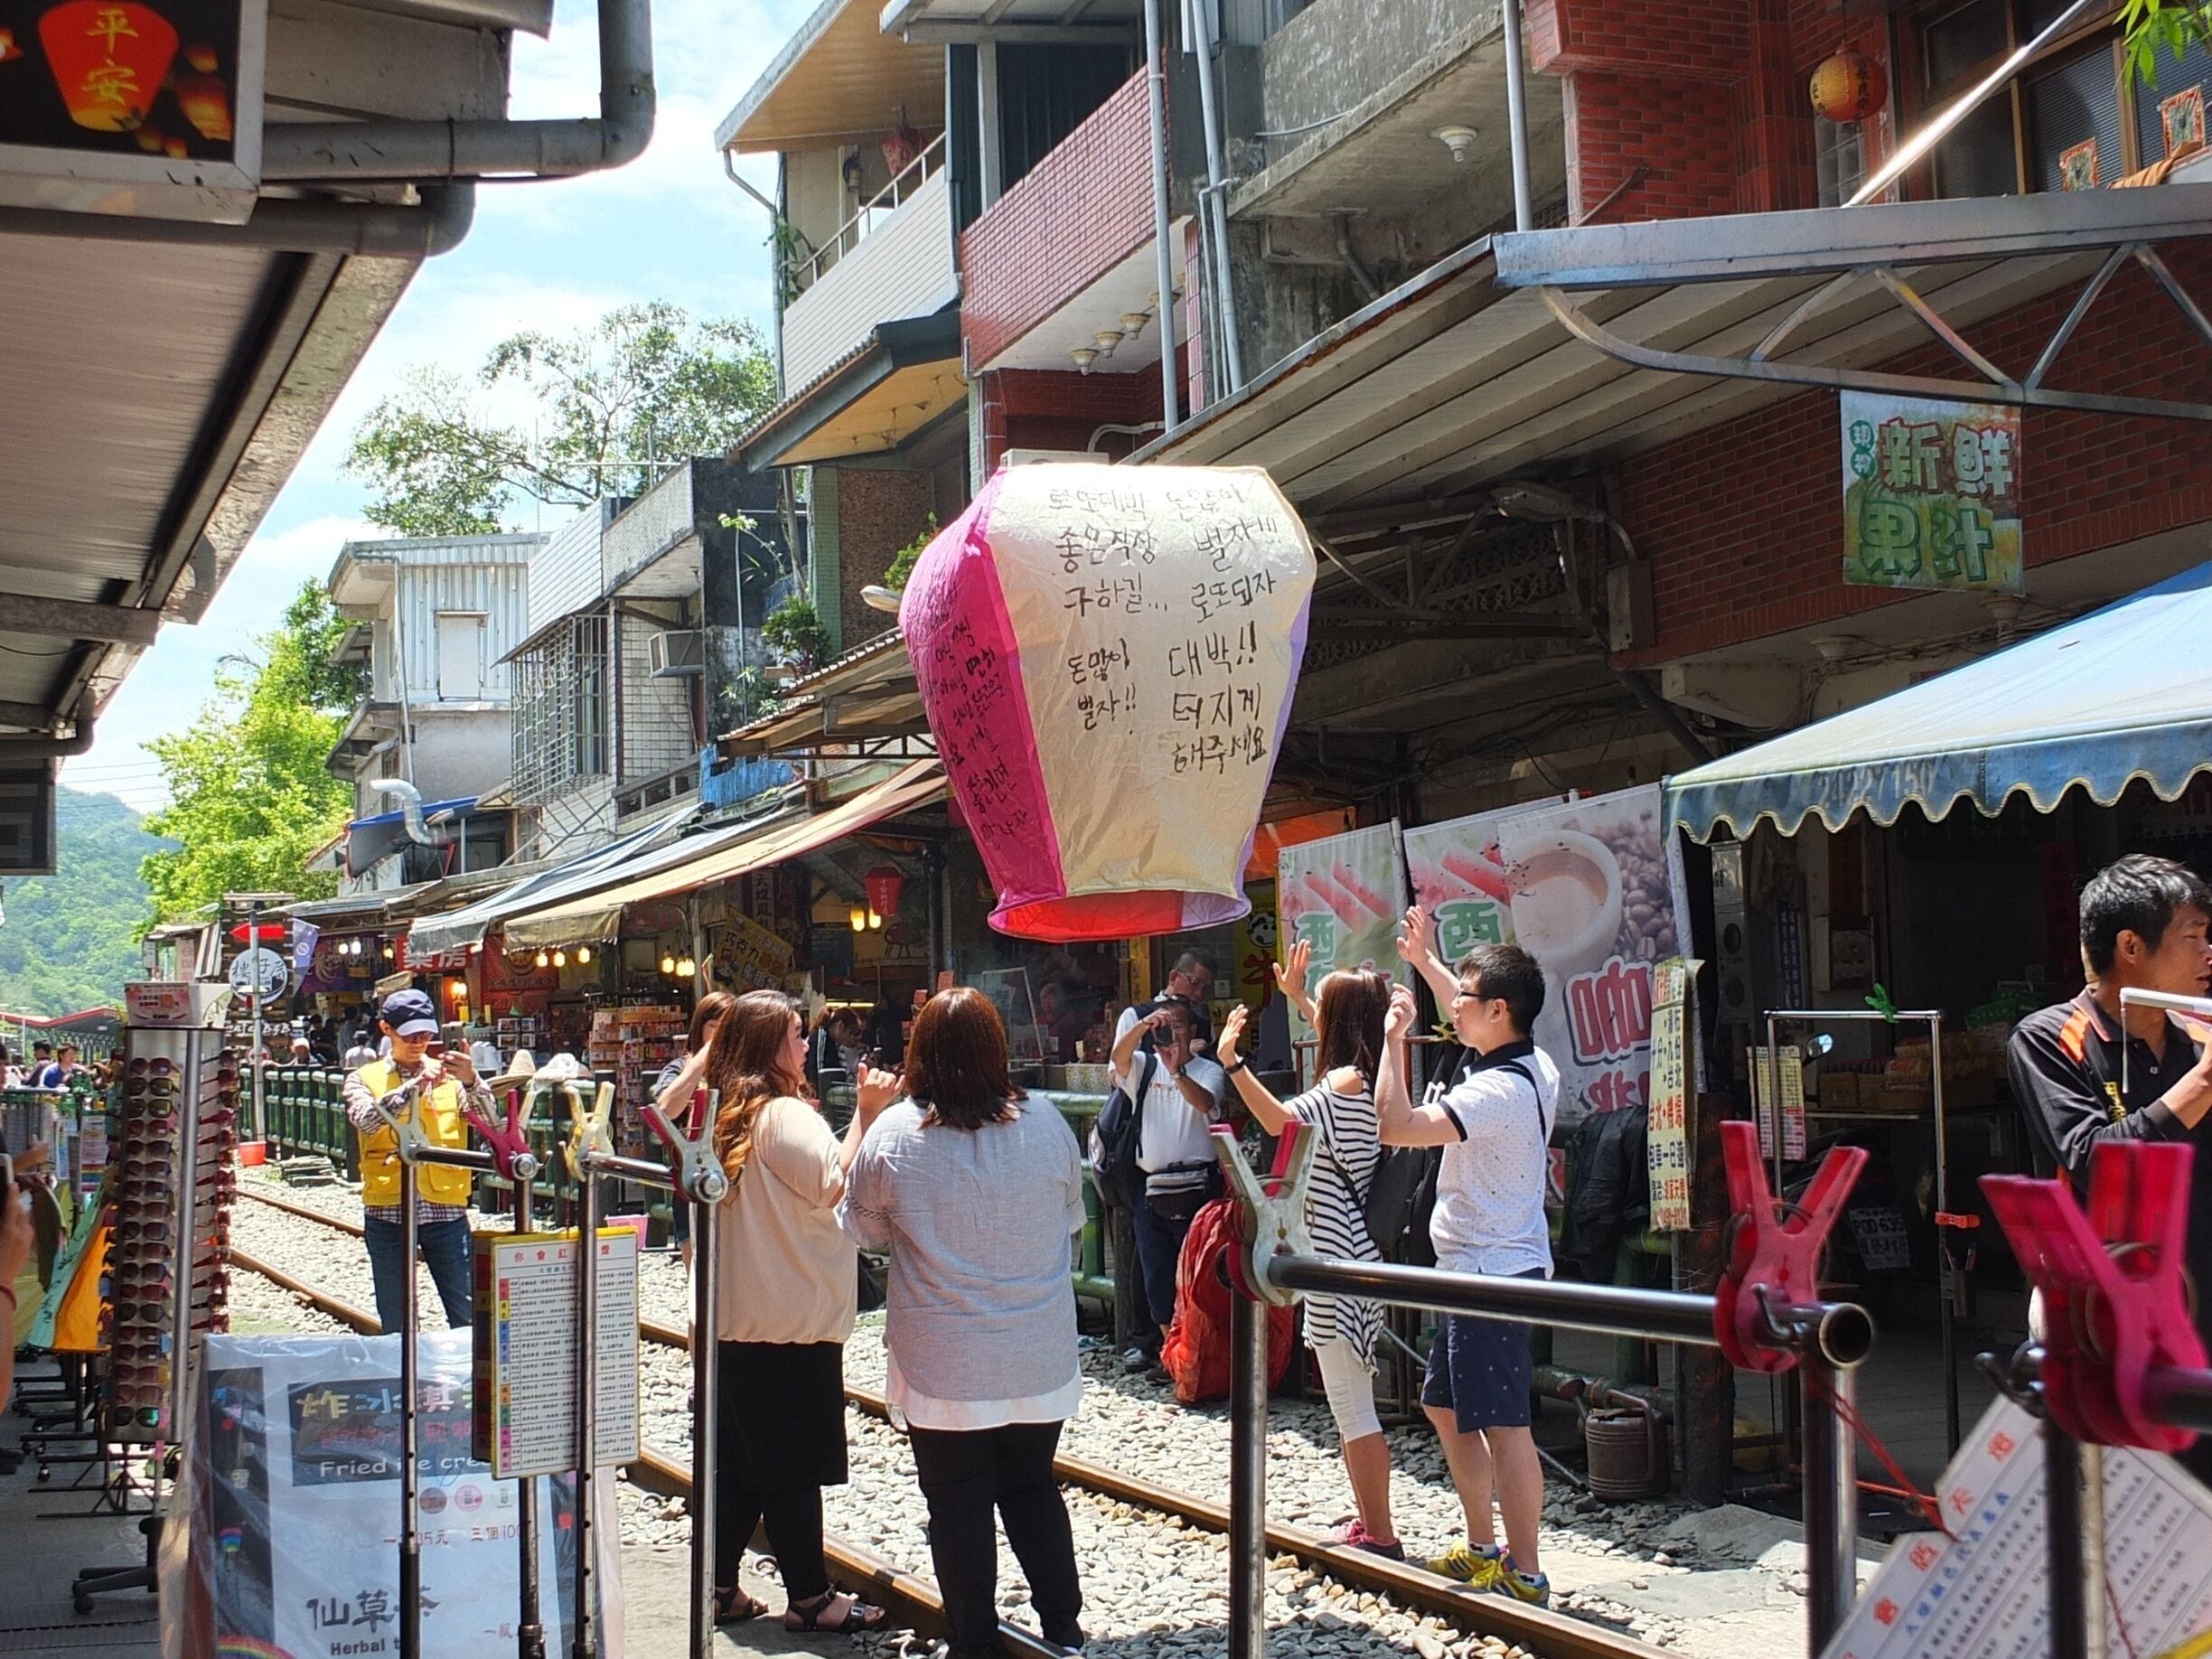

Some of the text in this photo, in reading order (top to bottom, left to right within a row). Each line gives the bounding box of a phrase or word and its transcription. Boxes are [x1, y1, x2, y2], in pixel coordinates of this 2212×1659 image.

[81, 8, 140, 106] 平安
[1879, 417, 2015, 497] 新鮮
[1859, 500, 1993, 581] 果汁
[514, 1244, 610, 1262] 你會紅燈
[320, 1457, 492, 1477] Fried ie cre
[331, 1638, 385, 1656] Herbal
